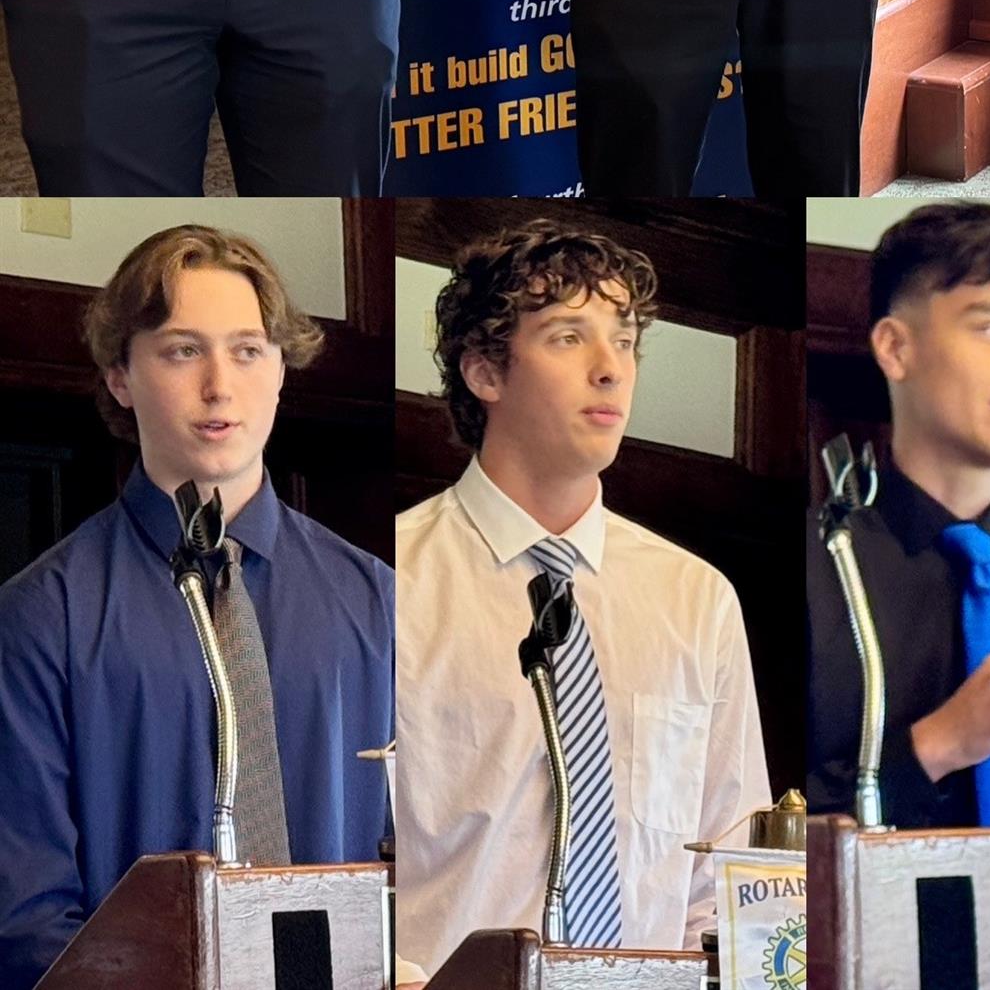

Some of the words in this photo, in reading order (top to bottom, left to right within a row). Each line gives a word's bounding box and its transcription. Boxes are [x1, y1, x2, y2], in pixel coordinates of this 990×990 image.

[409, 62, 435, 96] it
[447, 44, 528, 89] build
[498, 90, 576, 141] FRIE
[738, 877, 806, 907] ROTAR
